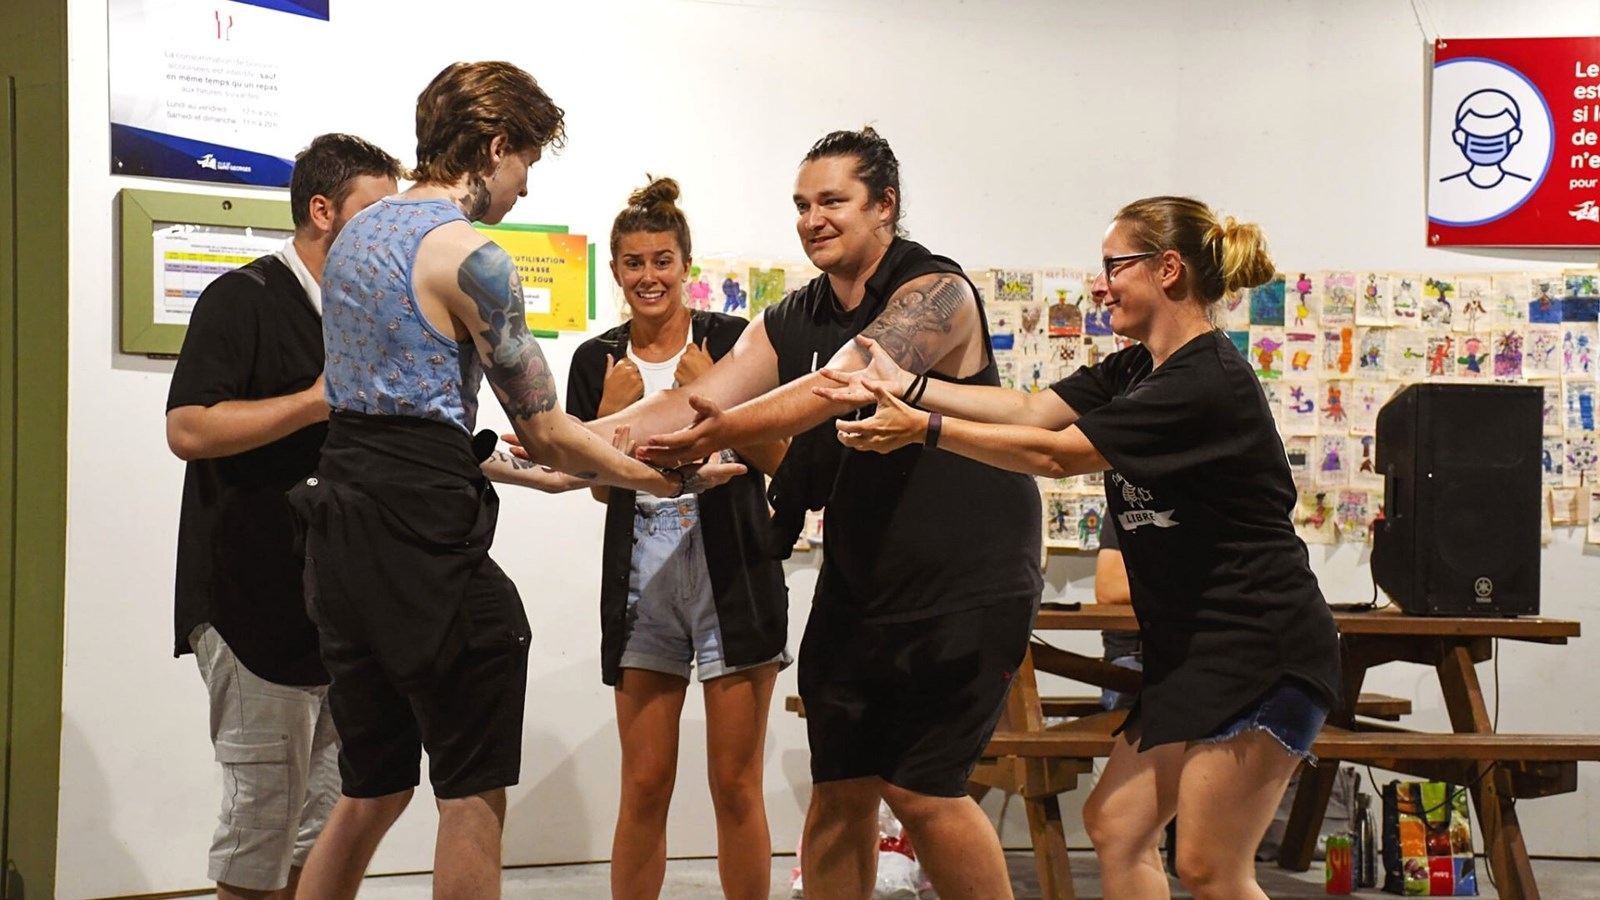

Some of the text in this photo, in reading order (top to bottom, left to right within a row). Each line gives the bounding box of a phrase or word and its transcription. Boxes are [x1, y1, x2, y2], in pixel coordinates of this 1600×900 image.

[1575, 61, 1600, 78] Le
[205, 77, 229, 87] temps
[255, 84, 278, 92] repas
[166, 99, 185, 109] Lundi
[166, 110, 194, 120] Samedi
[203, 114, 237, 125] dimanche
[1572, 105, 1588, 122] si
[1571, 128, 1597, 146] de
[1569, 179, 1598, 190] pour
[515, 256, 565, 264] UTILISATION
[533, 276, 553, 284] JOUR
[1126, 513, 1156, 523] LIBRE
